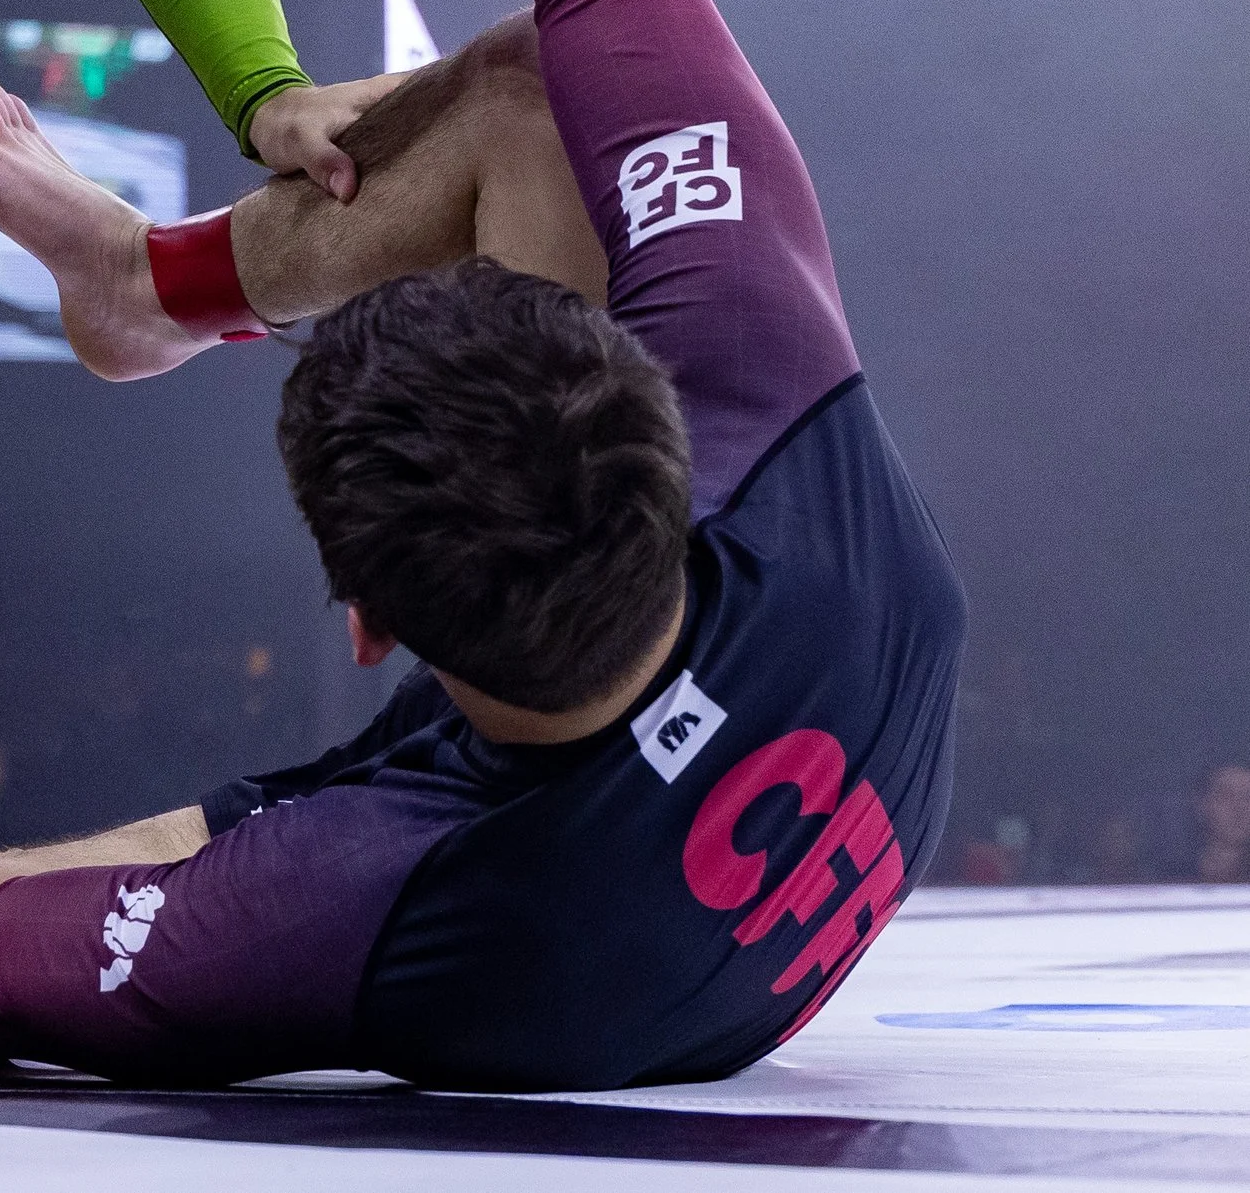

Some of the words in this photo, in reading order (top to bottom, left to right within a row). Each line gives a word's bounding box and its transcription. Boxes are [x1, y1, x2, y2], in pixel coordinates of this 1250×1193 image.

[628, 134, 714, 192] FC
[638, 175, 732, 232] CF
[682, 728, 906, 1044] CFF
